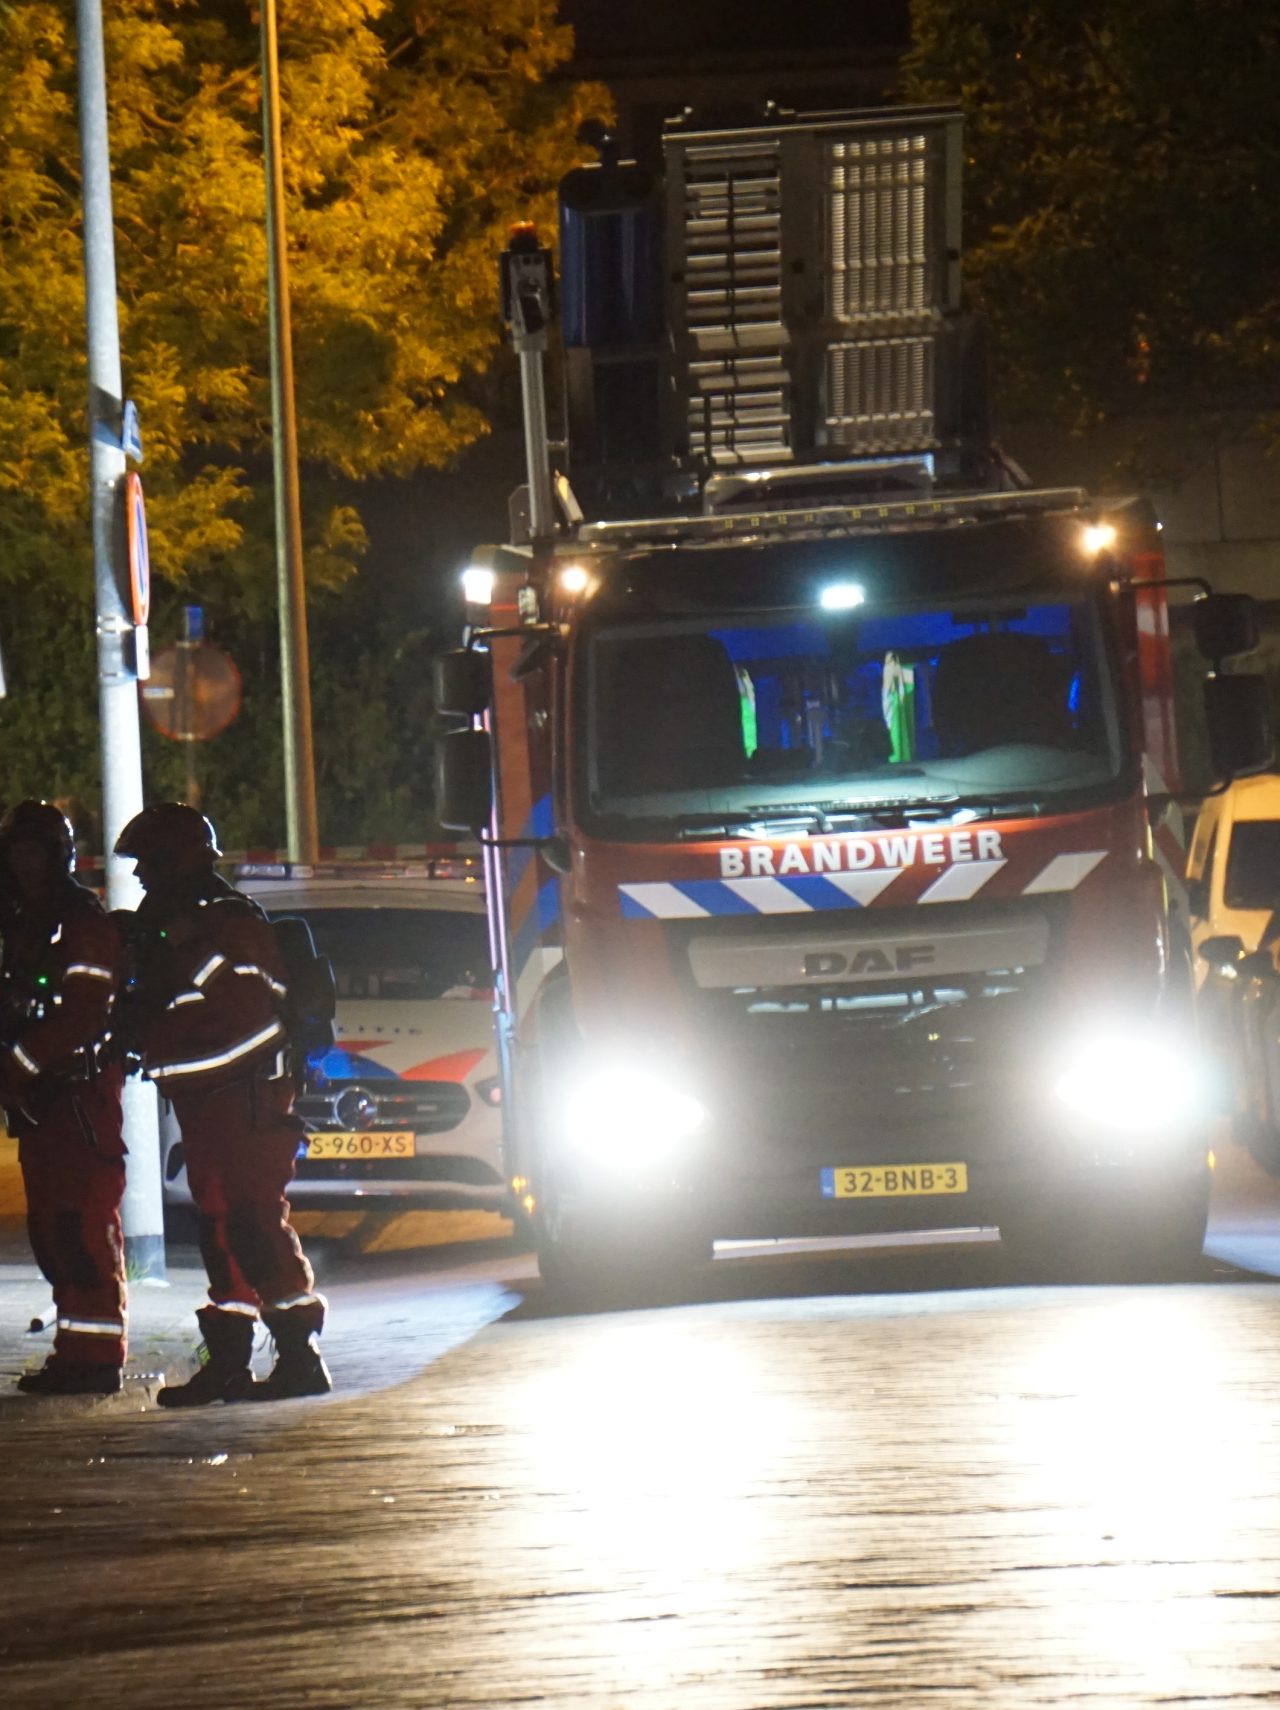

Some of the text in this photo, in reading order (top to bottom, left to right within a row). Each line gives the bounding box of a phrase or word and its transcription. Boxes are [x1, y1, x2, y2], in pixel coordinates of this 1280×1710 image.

[720, 829, 1005, 878] BRANDWEER
[804, 944, 936, 977] DAF
[312, 1135, 407, 1155] S-960-XS
[843, 1167, 959, 1194] 32-BNB-3
